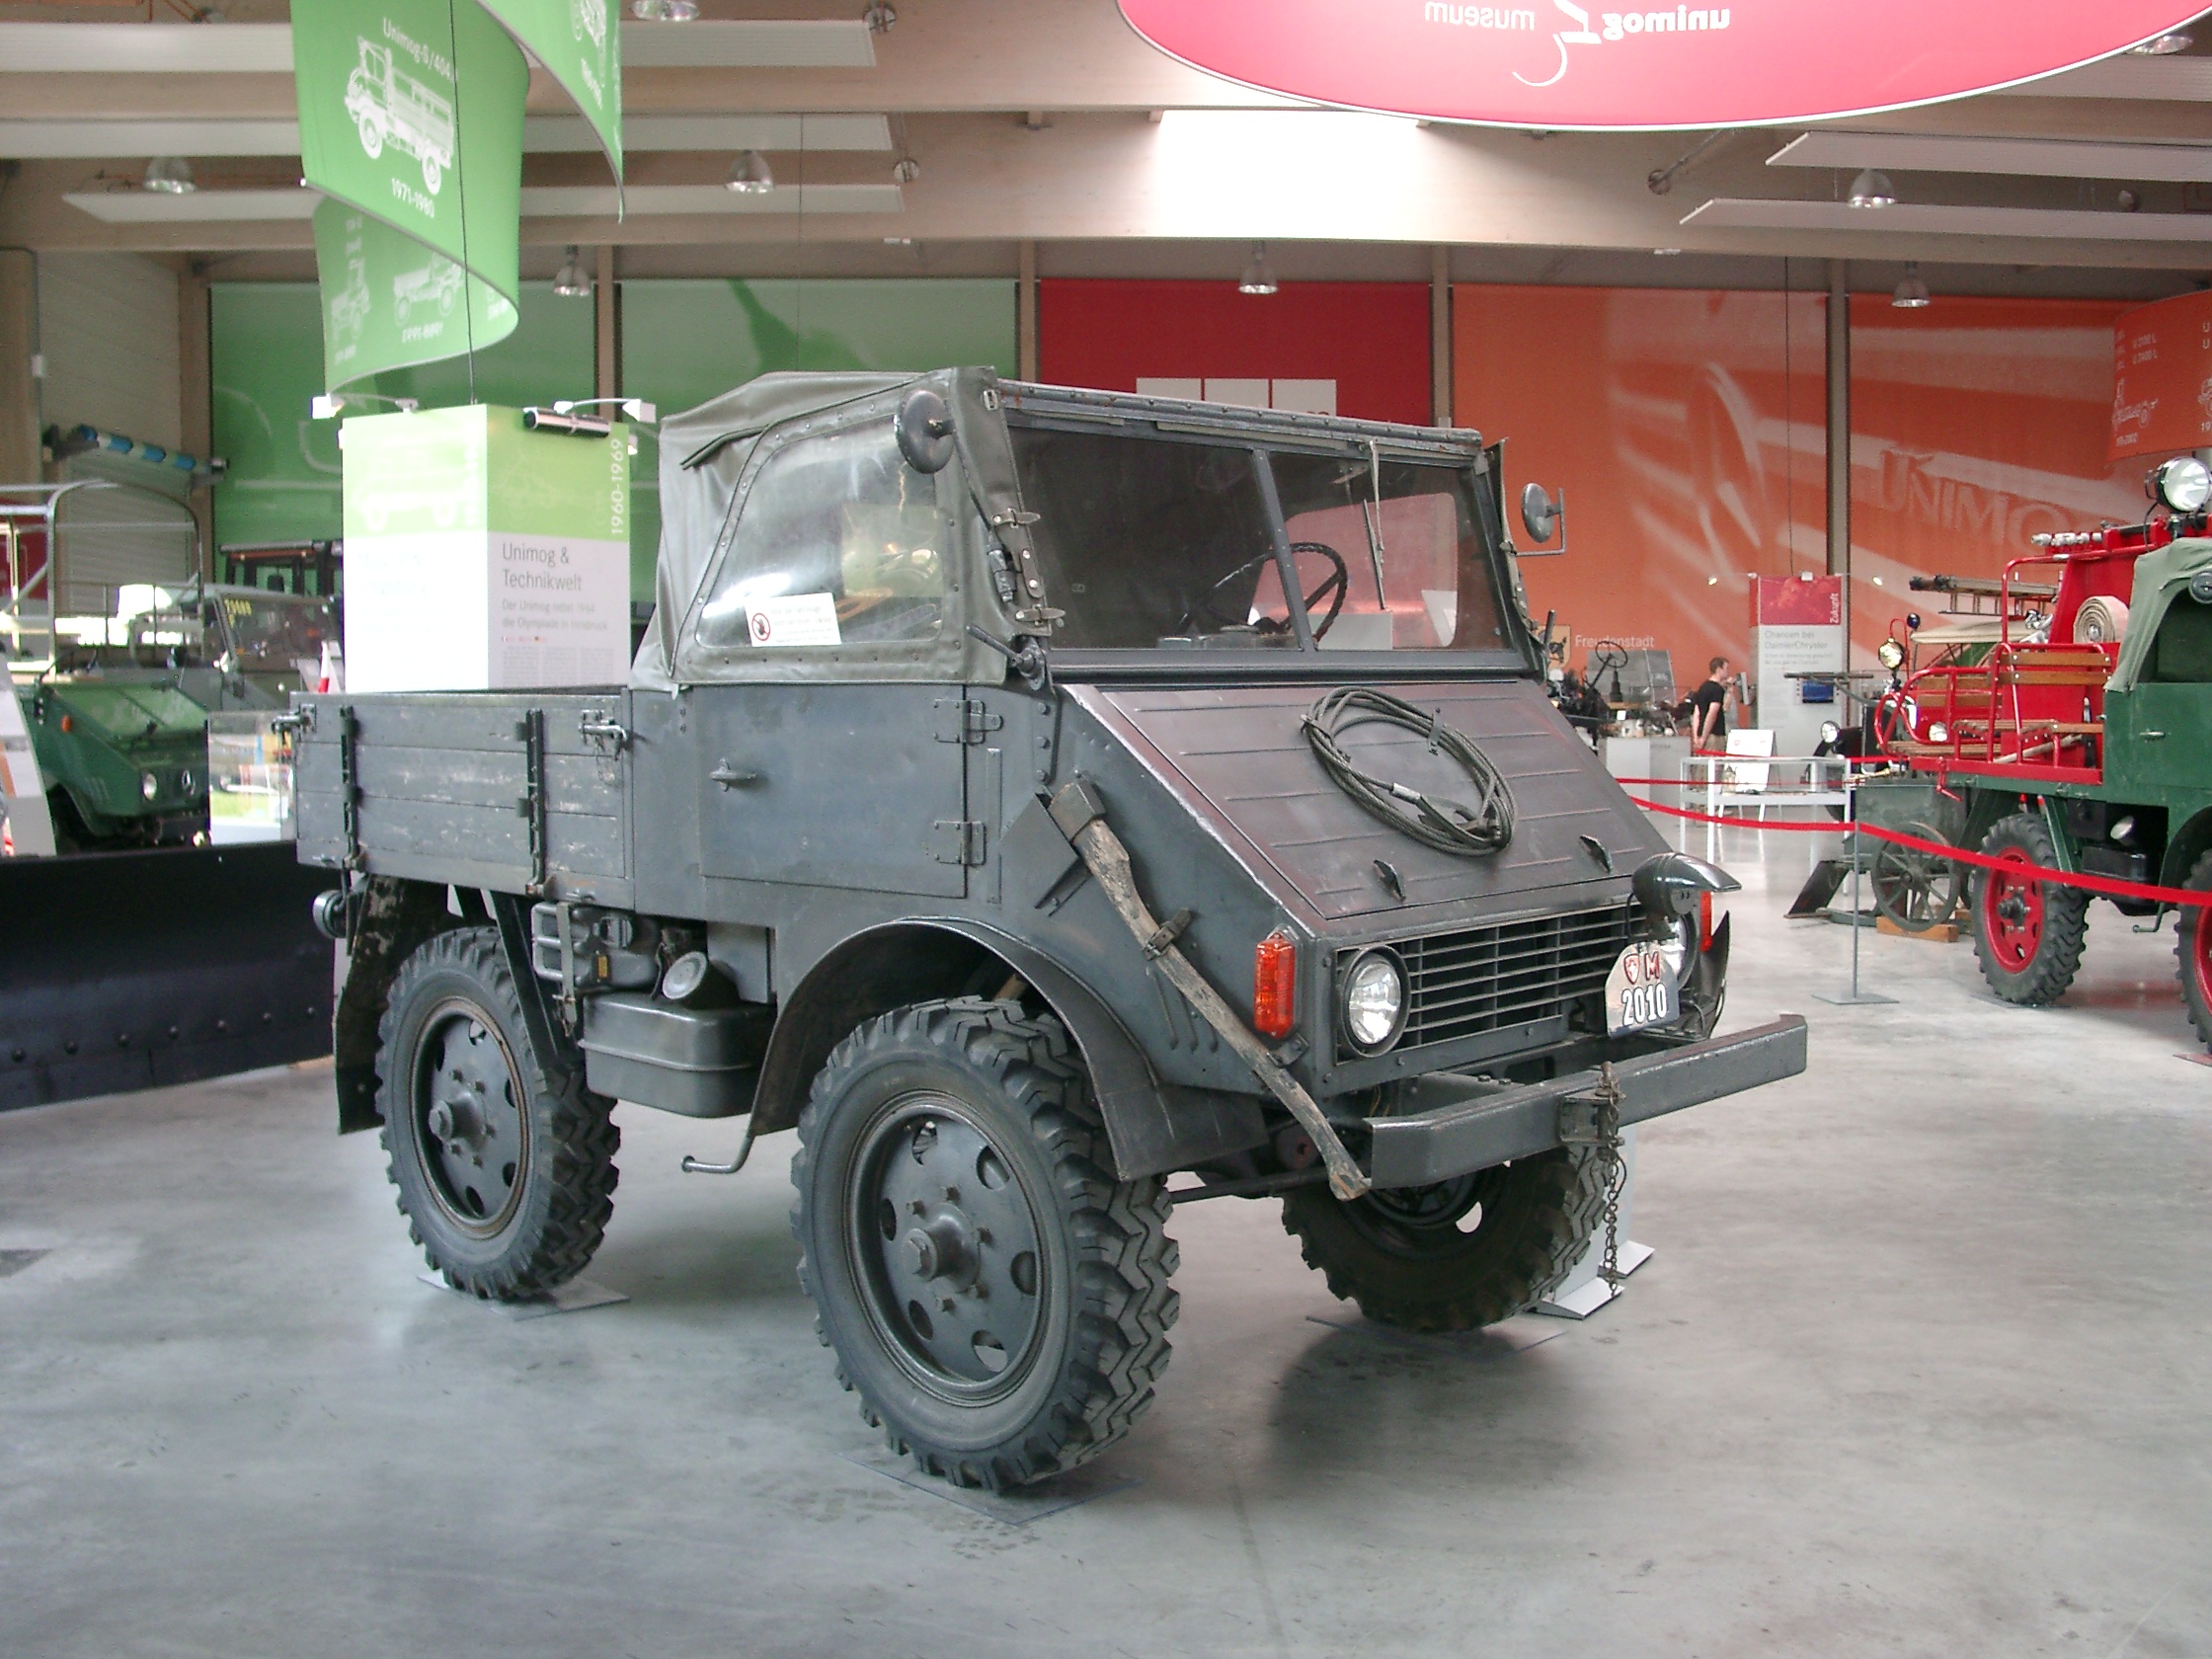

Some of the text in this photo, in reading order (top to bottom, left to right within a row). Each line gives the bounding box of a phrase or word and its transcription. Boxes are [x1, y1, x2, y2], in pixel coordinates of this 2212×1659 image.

[610, 438, 624, 534] 1960-1969
[502, 542, 569, 568] Unimog &
[503, 569, 582, 592] Technikwelt
[1644, 951, 1660, 981] M
[1621, 983, 1667, 1027] 2010
